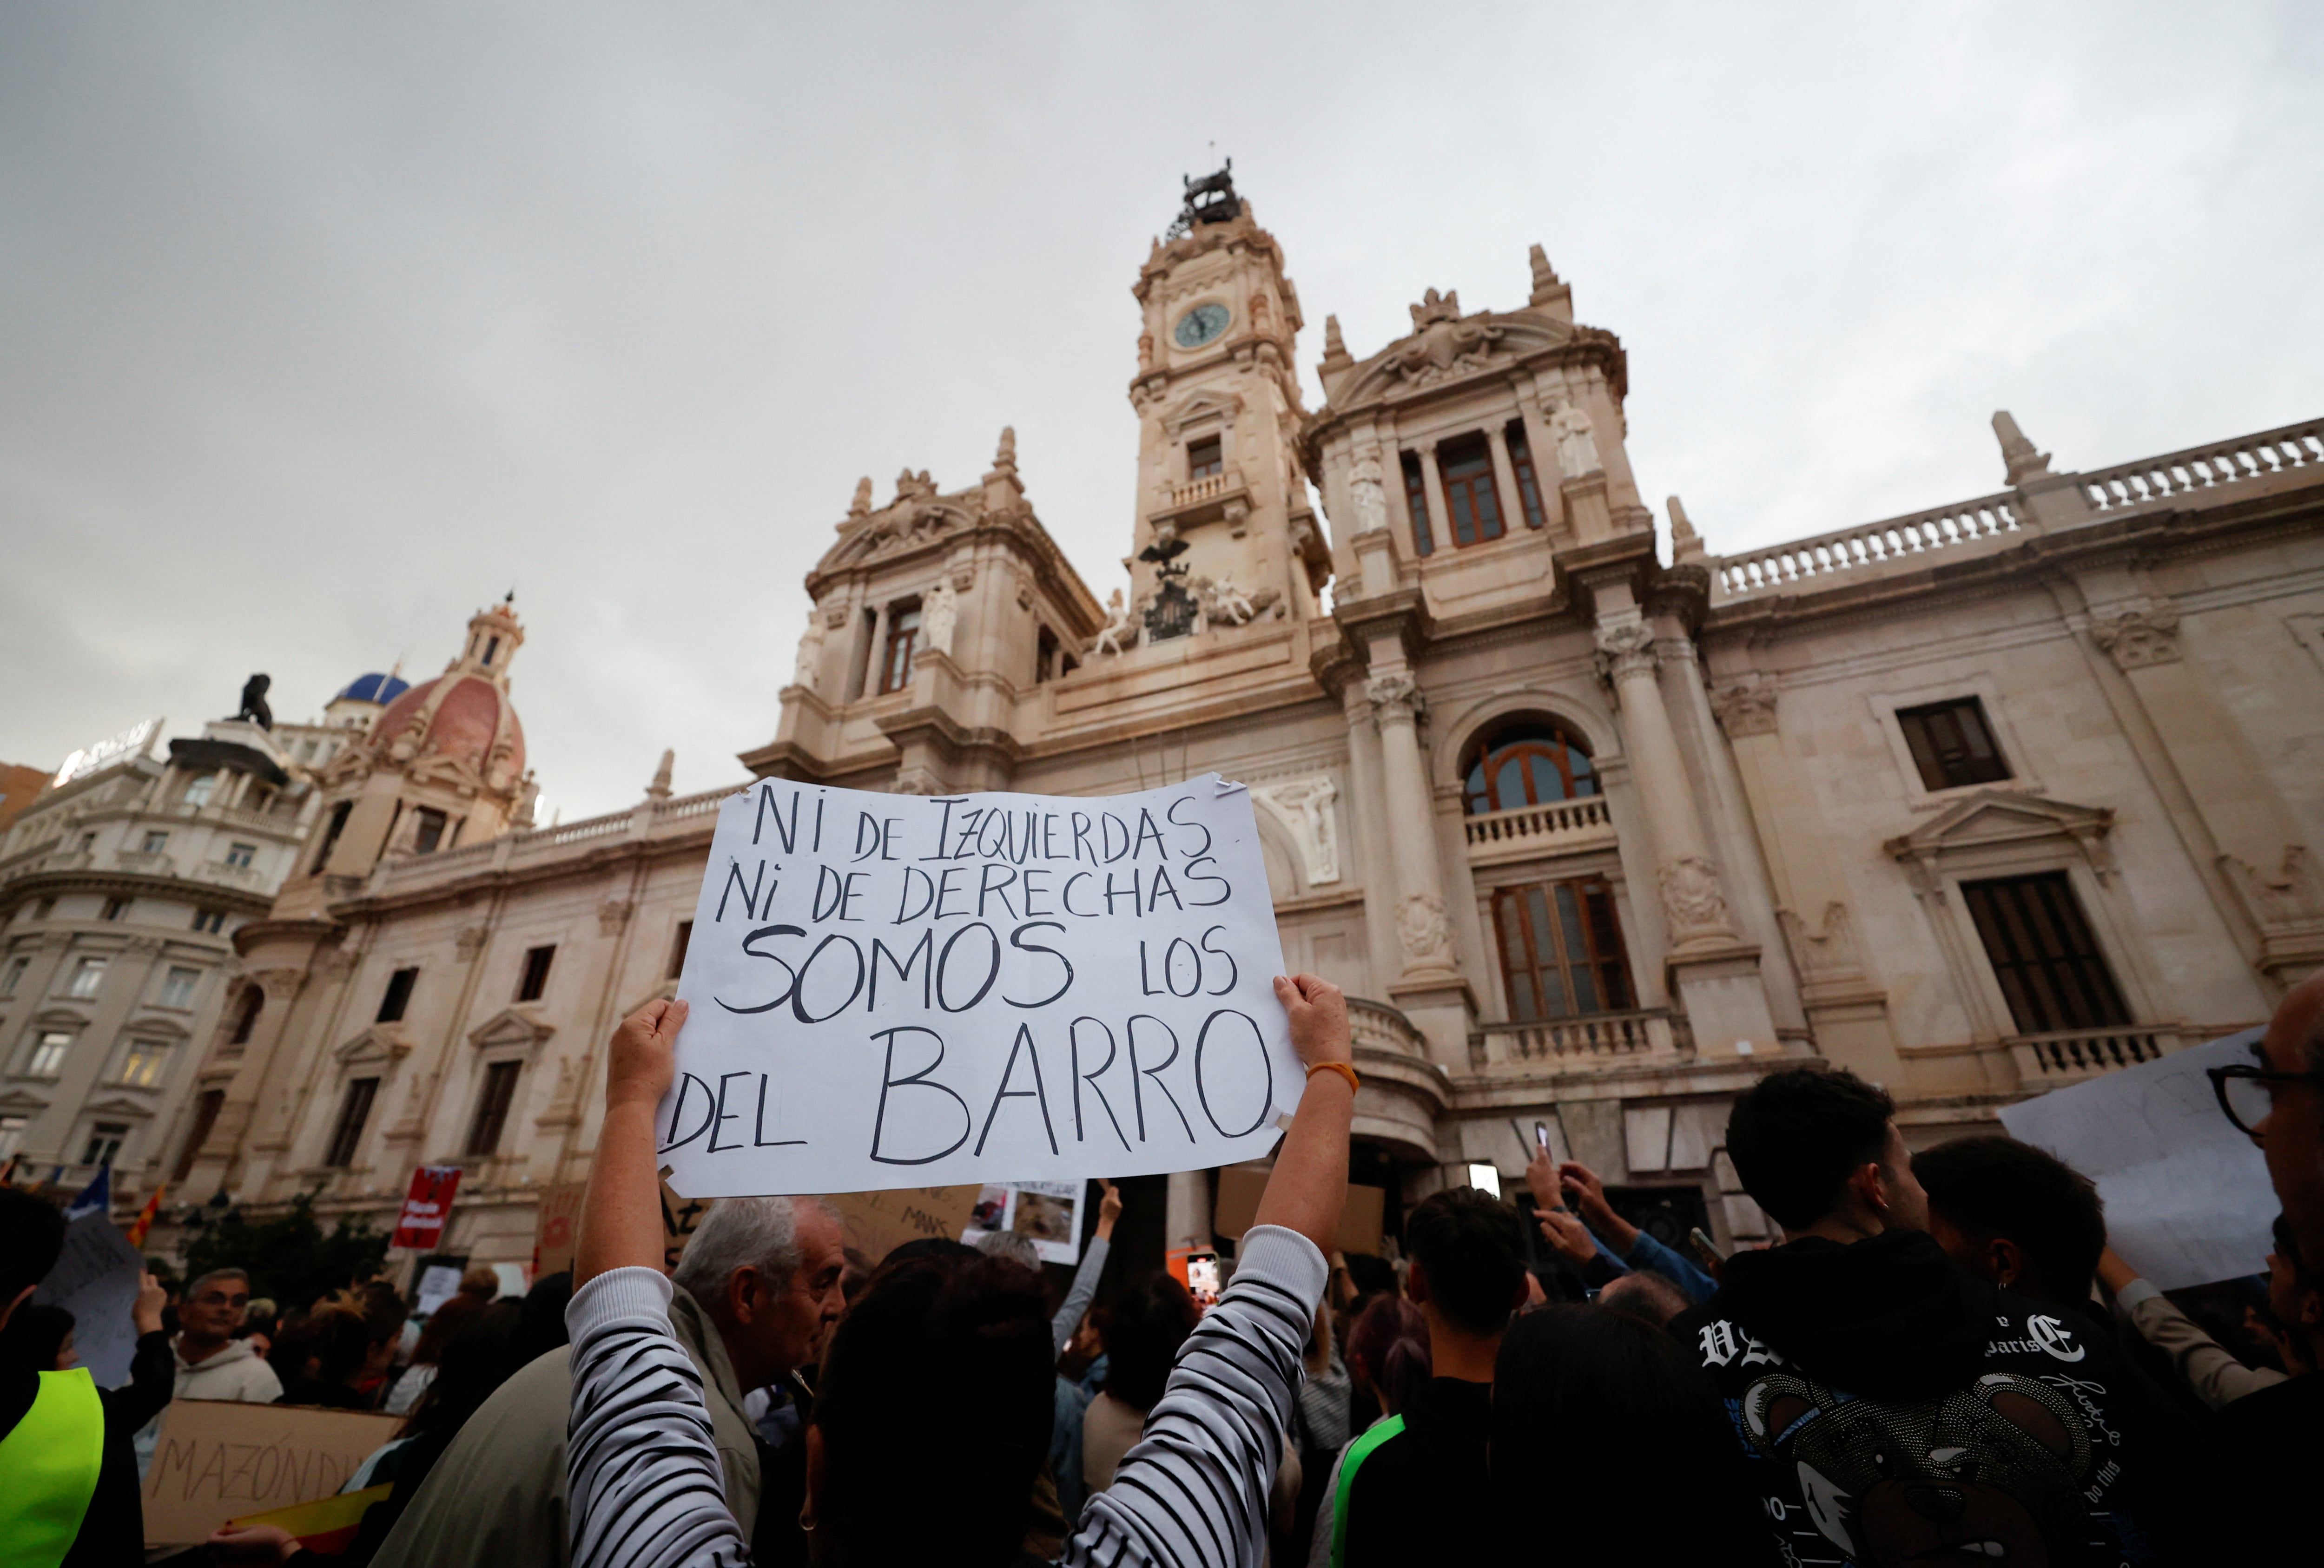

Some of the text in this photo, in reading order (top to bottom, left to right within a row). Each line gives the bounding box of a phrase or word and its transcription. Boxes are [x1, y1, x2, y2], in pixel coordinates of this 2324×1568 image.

[850, 810, 905, 863] DE
[812, 864, 872, 923] DE
[890, 857, 1232, 925] DERECHAS
[713, 922, 1238, 1024] SOMOS LOS
[656, 1009, 1273, 1166] DEL BARRO
